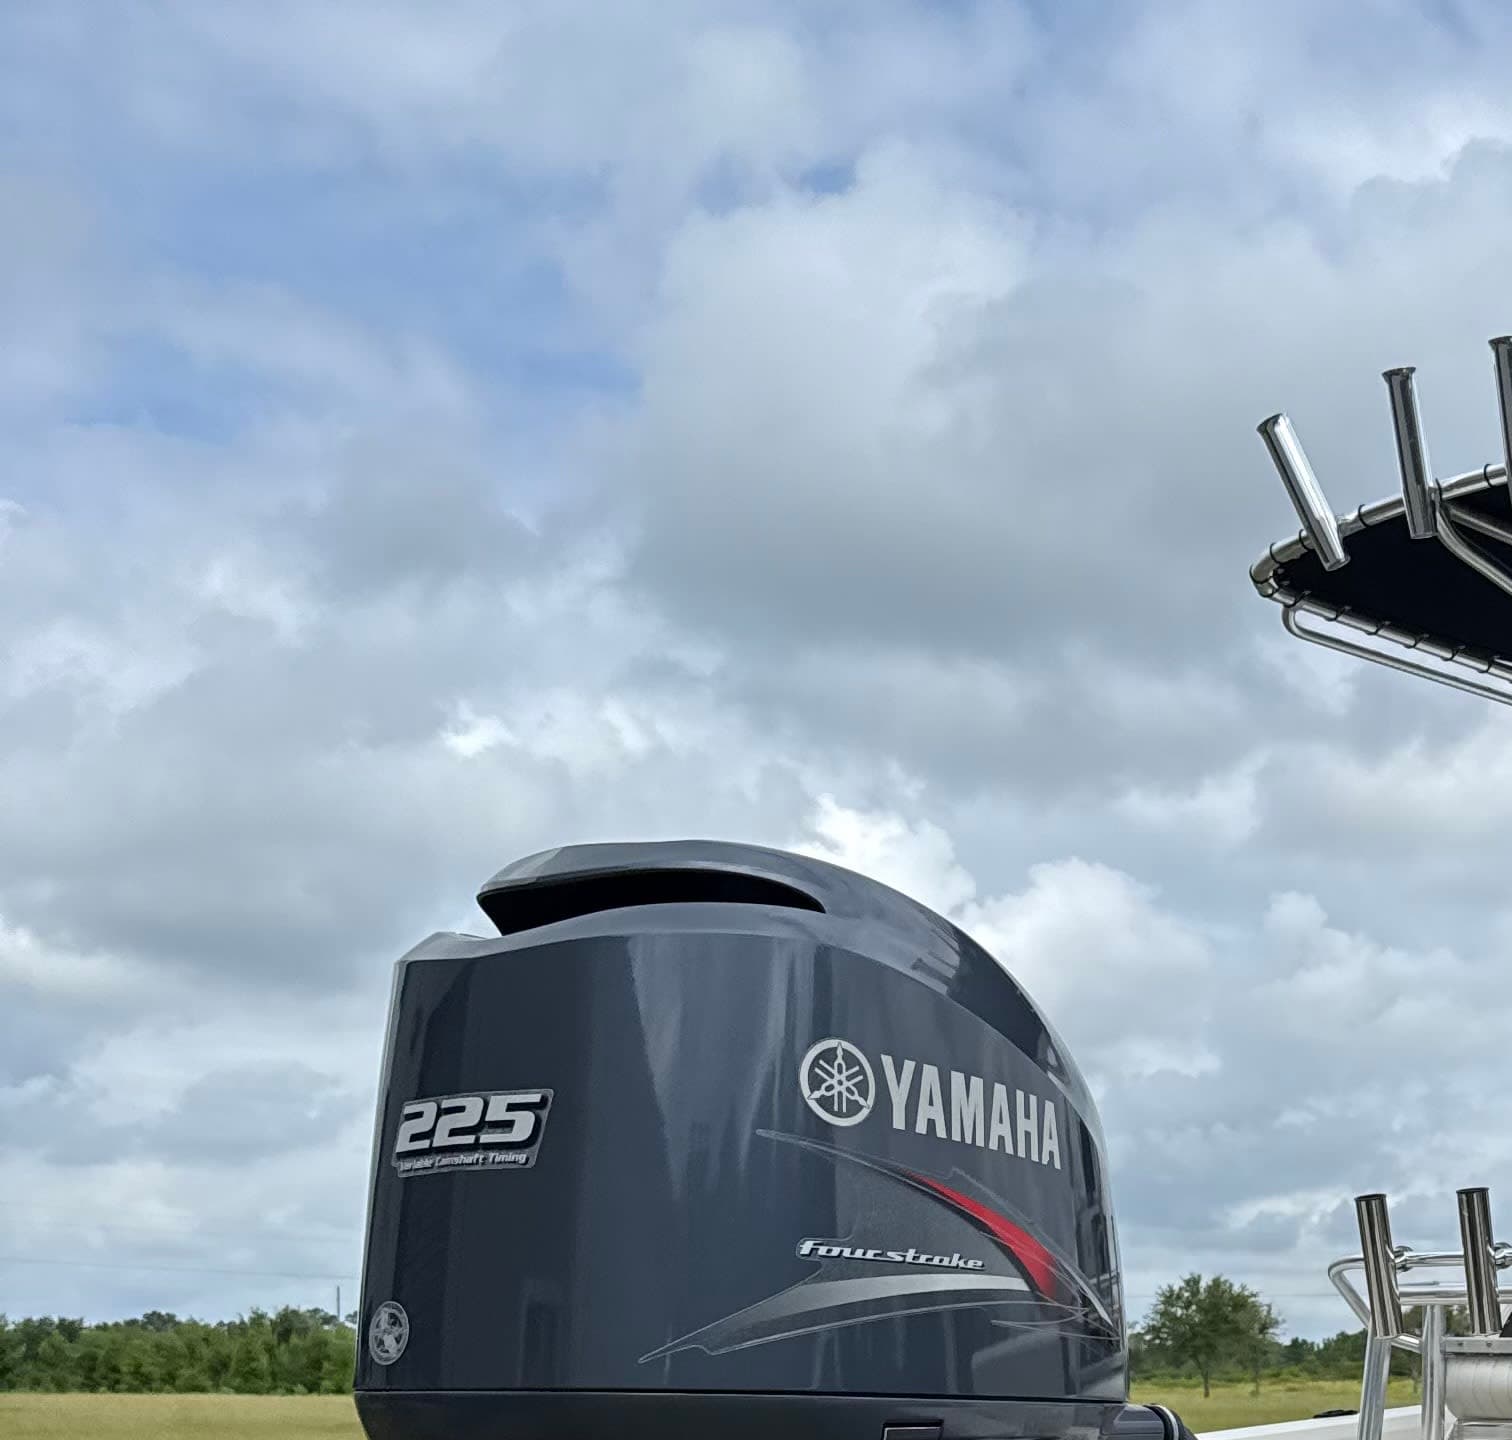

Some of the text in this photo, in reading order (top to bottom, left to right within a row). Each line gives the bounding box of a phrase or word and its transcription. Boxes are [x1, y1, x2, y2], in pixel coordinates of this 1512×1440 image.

[395, 1093, 542, 1153] 225
[881, 1054, 1061, 1170] YAMAHA
[488, 1152, 528, 1164] Timing
